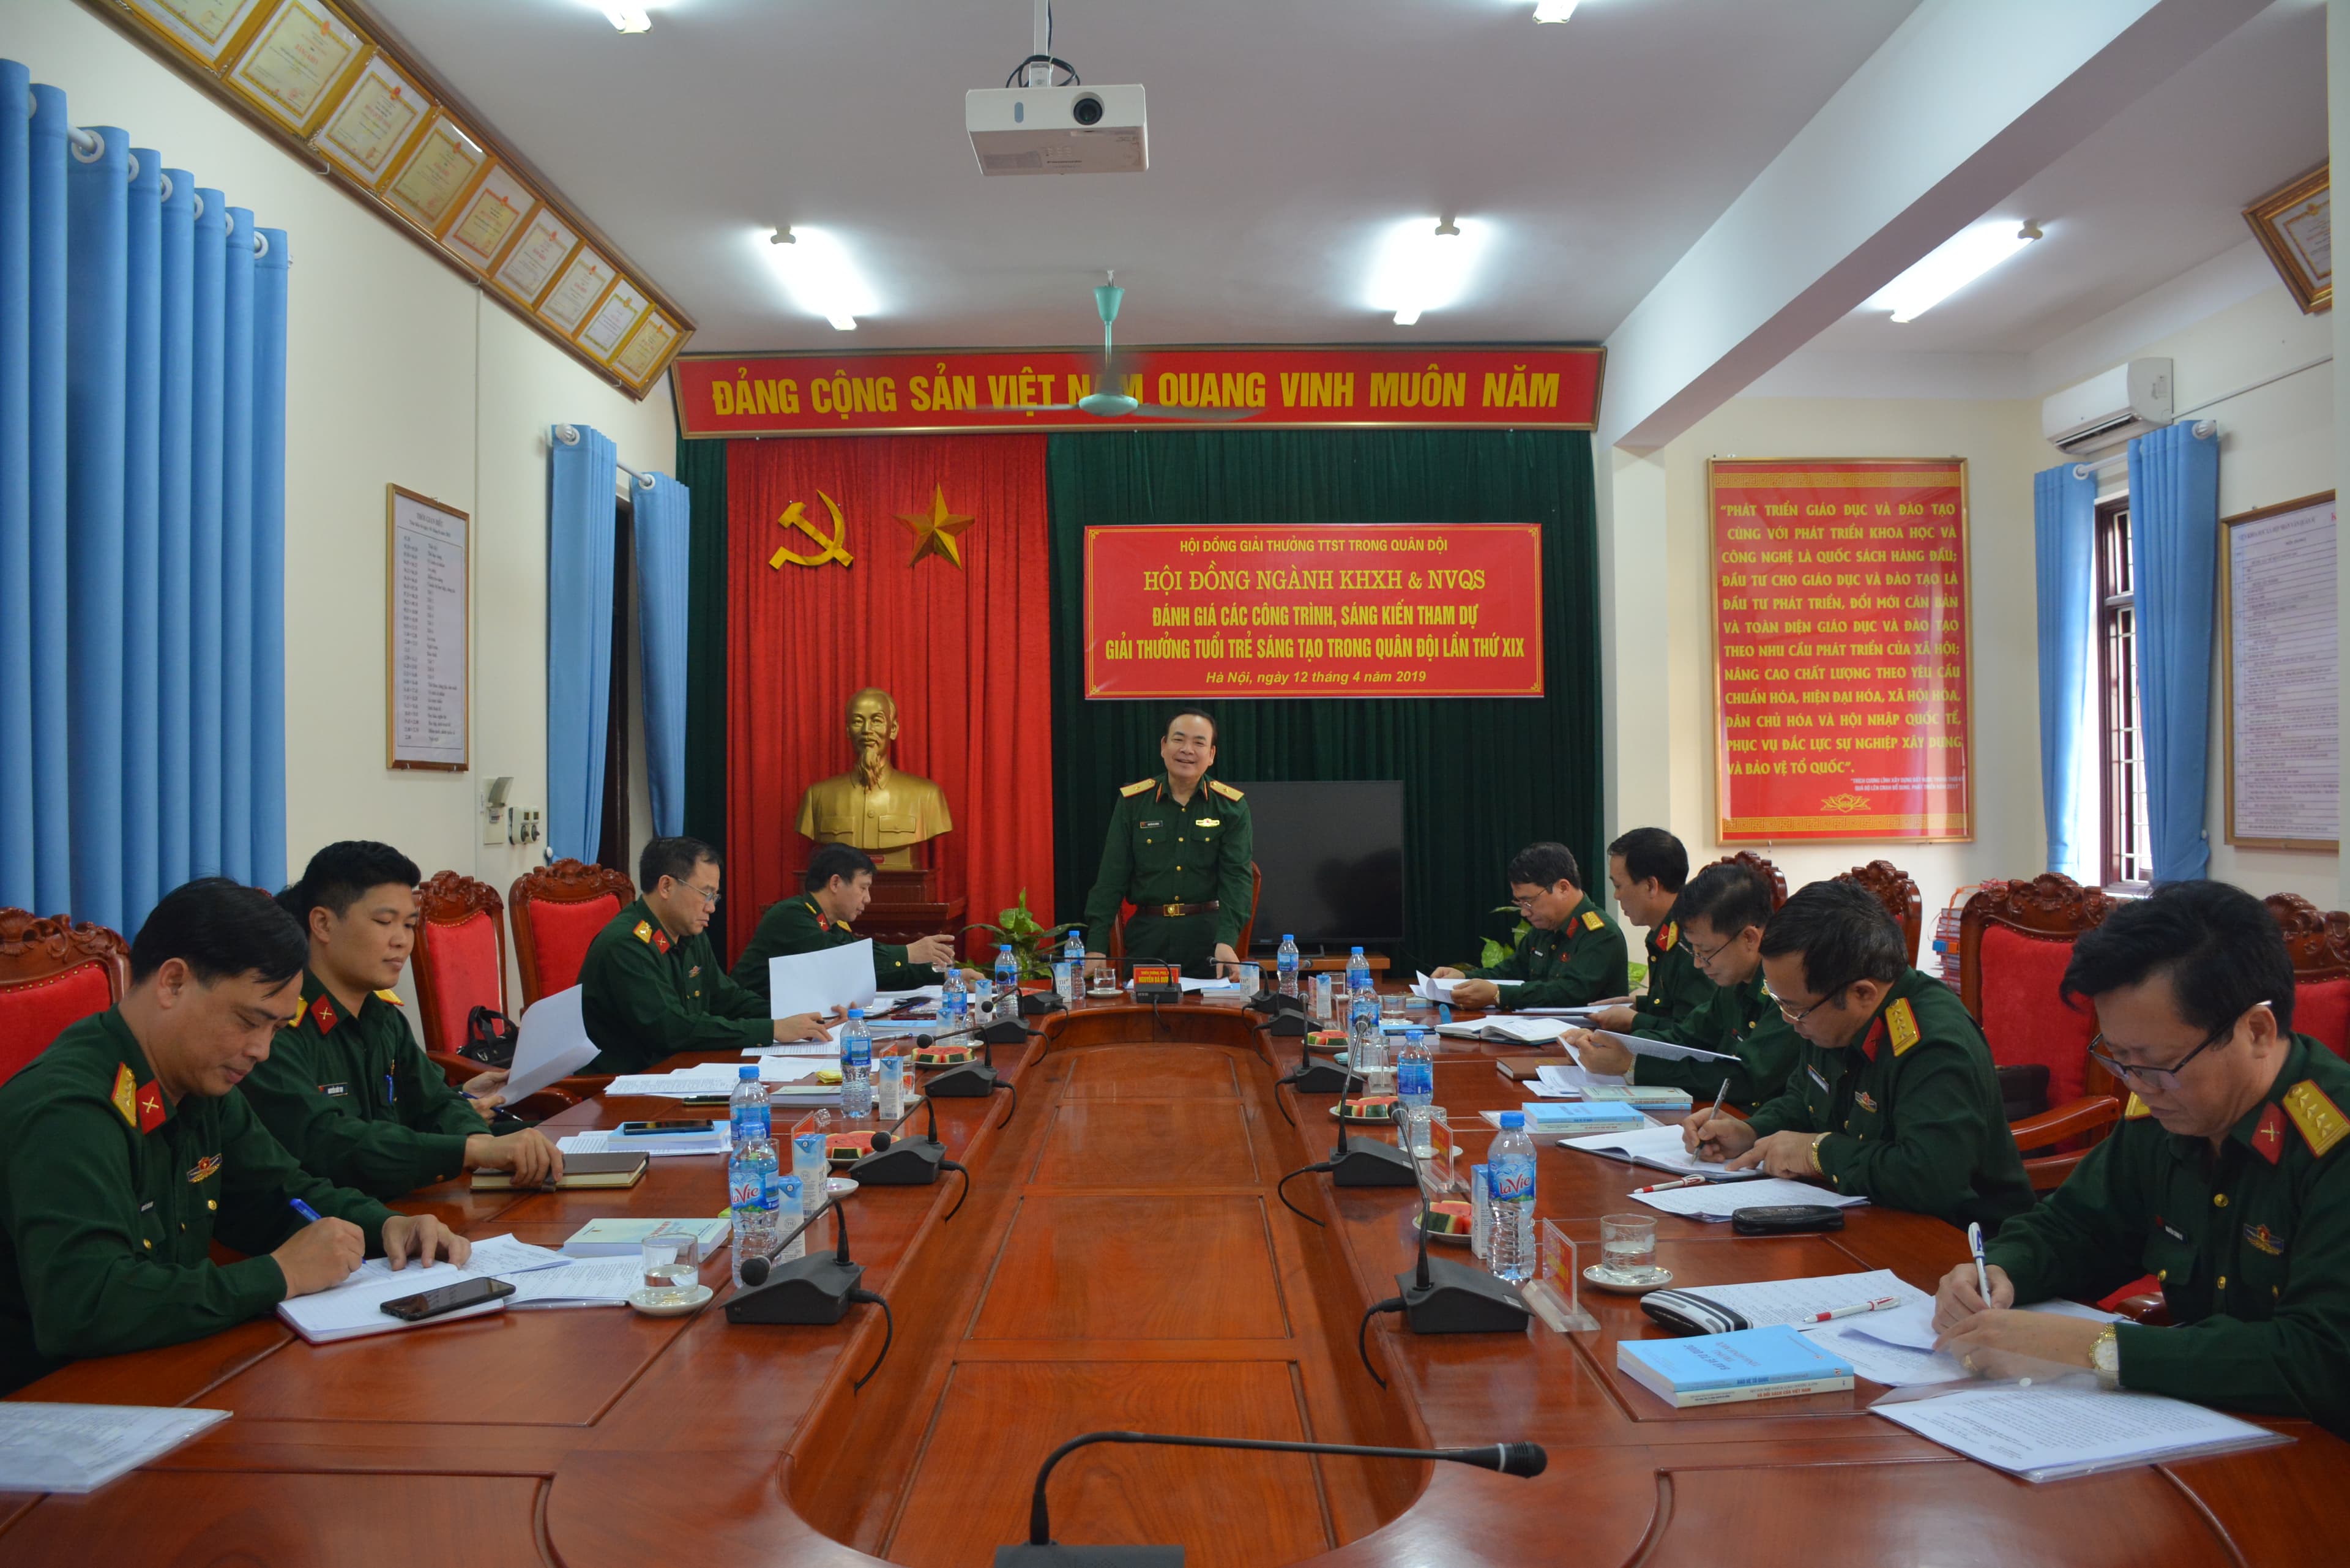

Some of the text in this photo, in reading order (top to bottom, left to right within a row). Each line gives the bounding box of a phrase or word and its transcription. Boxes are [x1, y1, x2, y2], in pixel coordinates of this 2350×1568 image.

[712, 367, 800, 415] ĐẢNG
[810, 368, 897, 420] CỘNG
[909, 362, 979, 412] SẢN
[985, 366, 1058, 417] VIỆT
[1067, 373, 1144, 406] NM
[1280, 371, 1354, 407] VINH
[1370, 363, 1466, 407] MUÔN
[1483, 364, 1560, 407] NĂM
[1764, 502, 1799, 517] TRIỂN
[1805, 504, 1837, 516] GIÁO
[1844, 504, 1868, 517] DỤC
[1875, 503, 1892, 515] VÀ
[1899, 503, 1924, 516] ĐÀO
[1931, 503, 1956, 515] TẠO
[1727, 524, 1957, 540] CÙNG VỚI PHÁT TRIỂN KHOA HỌC VÀ
[1180, 536, 1448, 553] HỘI ĐỒNG GIẢI THƯỞNG TTST TRONG QUÂN ĐỘI
[1721, 550, 1757, 564] CÔNG
[1761, 549, 1793, 564] NGHỆ
[1798, 550, 1813, 563] LÀ
[1816, 548, 1851, 563] QUỐC
[1856, 548, 1887, 562] SÁCH
[1891, 549, 1925, 562] HÀNG
[1144, 560, 1486, 595] HỘI ĐỒNG NGÀNH KHXH & NVQS
[1751, 575, 1768, 587] TƯ
[1771, 574, 1798, 586] CHO
[1802, 573, 1832, 586] GIÁO
[1837, 574, 1861, 587] DỤC
[1865, 573, 1882, 586] VÀ
[1886, 573, 1912, 586] ĐÀO
[1916, 573, 1941, 586] TẠO
[1944, 572, 1958, 585] LÀ
[1752, 597, 1769, 610] TƯ
[1773, 597, 1803, 610] PHÁT
[1808, 594, 1845, 610] TRIỂN,
[1850, 594, 1872, 609] ĐỔI
[1876, 595, 1900, 609] MỚI
[1904, 595, 1930, 608] CĂN
[1152, 600, 1479, 629] ĐÁNH GIÁ CÁC CÔNG TRÌNH, SÁNG KIẾN THAM DỰ
[1723, 621, 1740, 633] VÀ
[1745, 621, 1780, 633] TOÀN
[1785, 619, 1812, 634] DIỆN
[1817, 620, 1848, 633] GIÁO
[1853, 620, 1877, 633] DỤC
[1882, 619, 1899, 632] VÀ
[1904, 618, 1931, 632] ĐÀO
[1106, 630, 1525, 662] GIẢI THƯỞNG TUỔI TRẺ SÁNG TẠO TRONG QUÂN ĐỘI LẦN THỨ XIX
[1724, 645, 1755, 657] THEO
[1758, 645, 1785, 657] NHU
[1788, 641, 1813, 657] CẦU
[1816, 643, 1846, 657] PHÁT
[1850, 640, 1884, 656] TRIỂN
[1887, 643, 1912, 655] CỦA
[1915, 640, 1930, 655] XÃ
[1206, 670, 1427, 685] Hà Nội, ngày 12 tháng 4 năm 2019
[1725, 667, 1759, 681] NÂNG
[1764, 668, 1790, 681] CAO
[1794, 665, 1826, 680] CHẤT
[1830, 667, 1871, 681] LƯỢNG
[1876, 666, 1907, 679] THEO
[1725, 689, 1767, 704] CHUẨN
[1769, 690, 1799, 704] HÓA,
[1802, 689, 1830, 705] HIỆN
[1832, 691, 1853, 703] ĐẠI
[1856, 689, 1885, 703] HÓA,
[1889, 688, 1905, 702] XÃ
[1756, 715, 1781, 728] CHỦ
[1786, 714, 1813, 727] HÓA
[1818, 714, 1835, 726] VÀ
[1840, 712, 1862, 727] HỘI
[1868, 712, 1900, 726] NHẬP
[1761, 739, 1778, 752] VỤ
[1781, 736, 1806, 751] ĐẮC
[1810, 738, 1832, 752] LỰC
[1836, 737, 1852, 750] SỰ
[1855, 735, 1898, 750] NGHIỆP
[1745, 760, 1771, 775] BẢO
[1773, 761, 1788, 775] VỆ
[1791, 758, 1807, 774] TỔ
